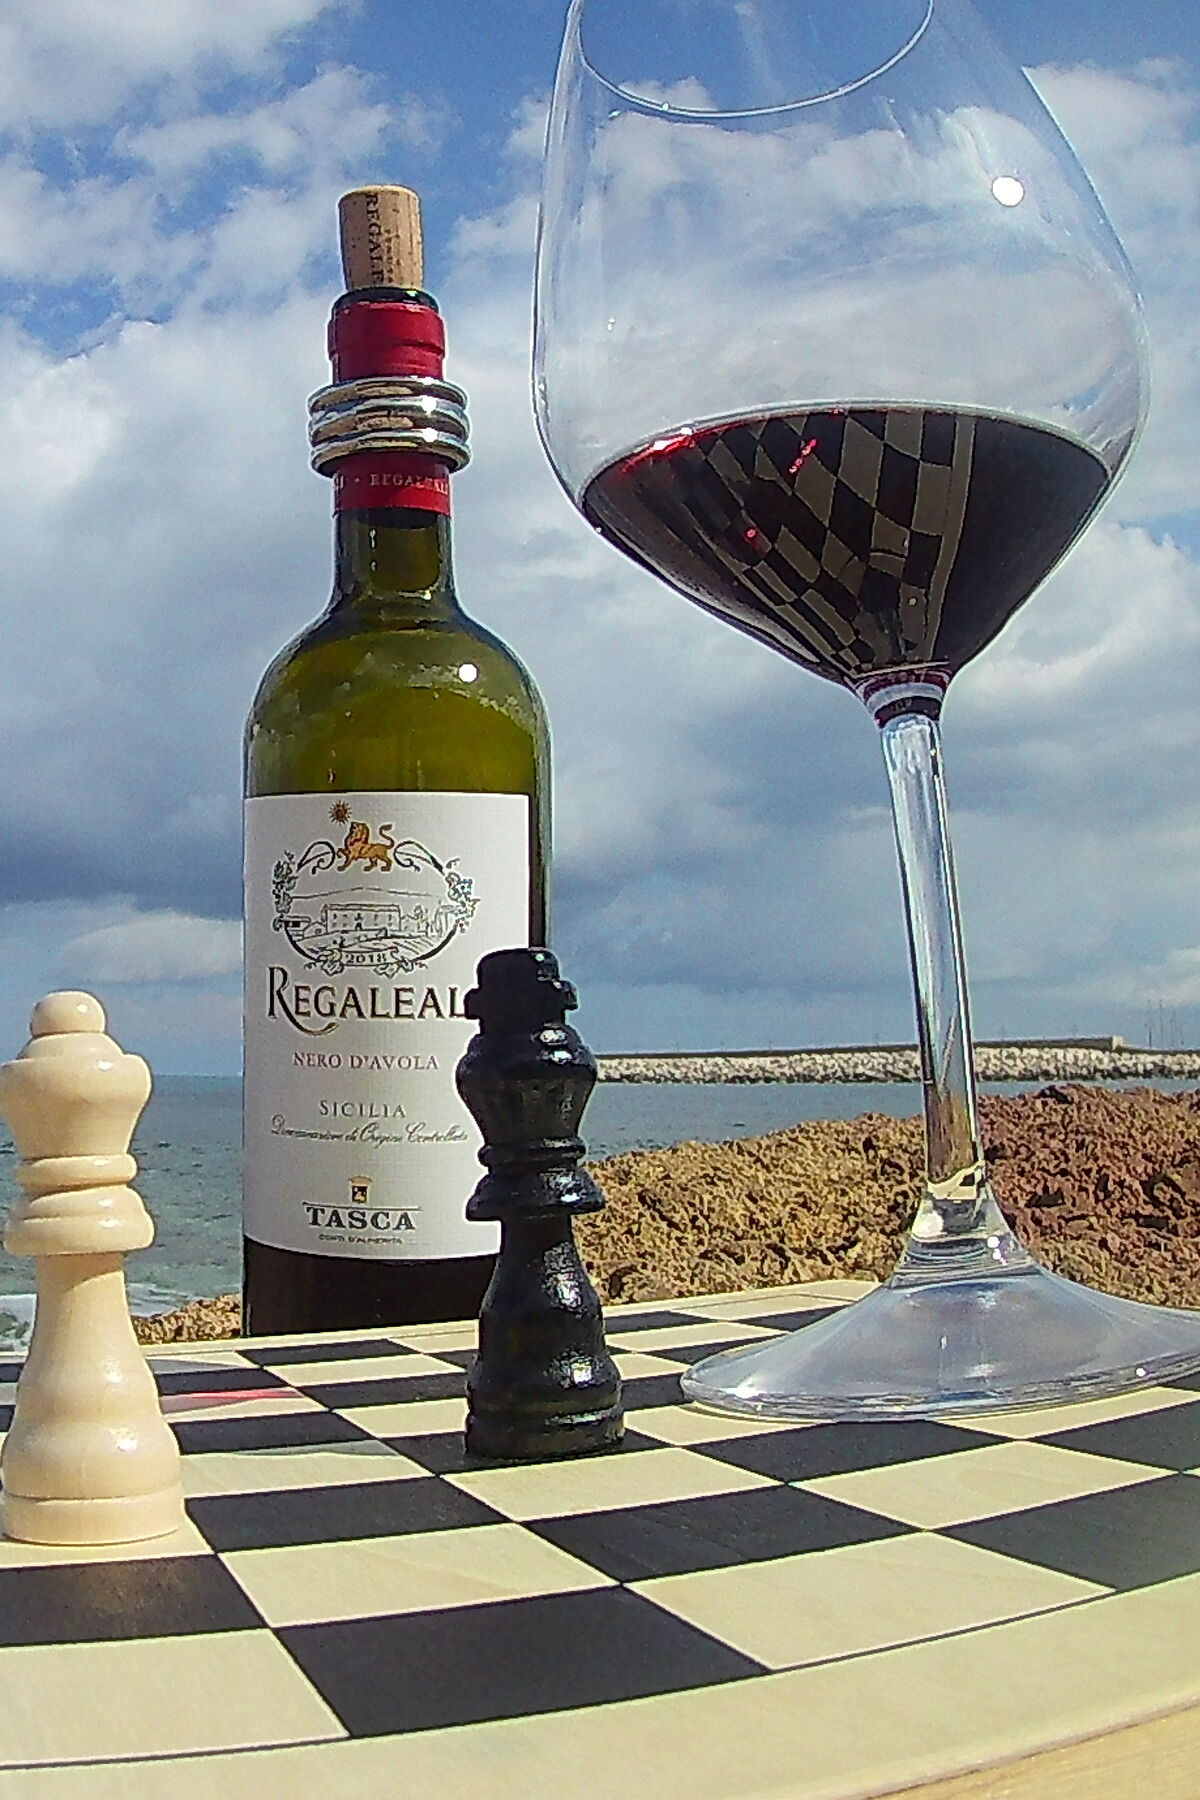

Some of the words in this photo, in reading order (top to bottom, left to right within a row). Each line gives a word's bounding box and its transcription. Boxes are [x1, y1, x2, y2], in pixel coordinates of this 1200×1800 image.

[344, 953, 388, 964] 2018
[293, 1051, 342, 1069] NERO
[349, 1054, 439, 1071] D'AVOLA
[319, 1099, 407, 1118] SICILIA
[305, 1206, 416, 1231] TASCA
